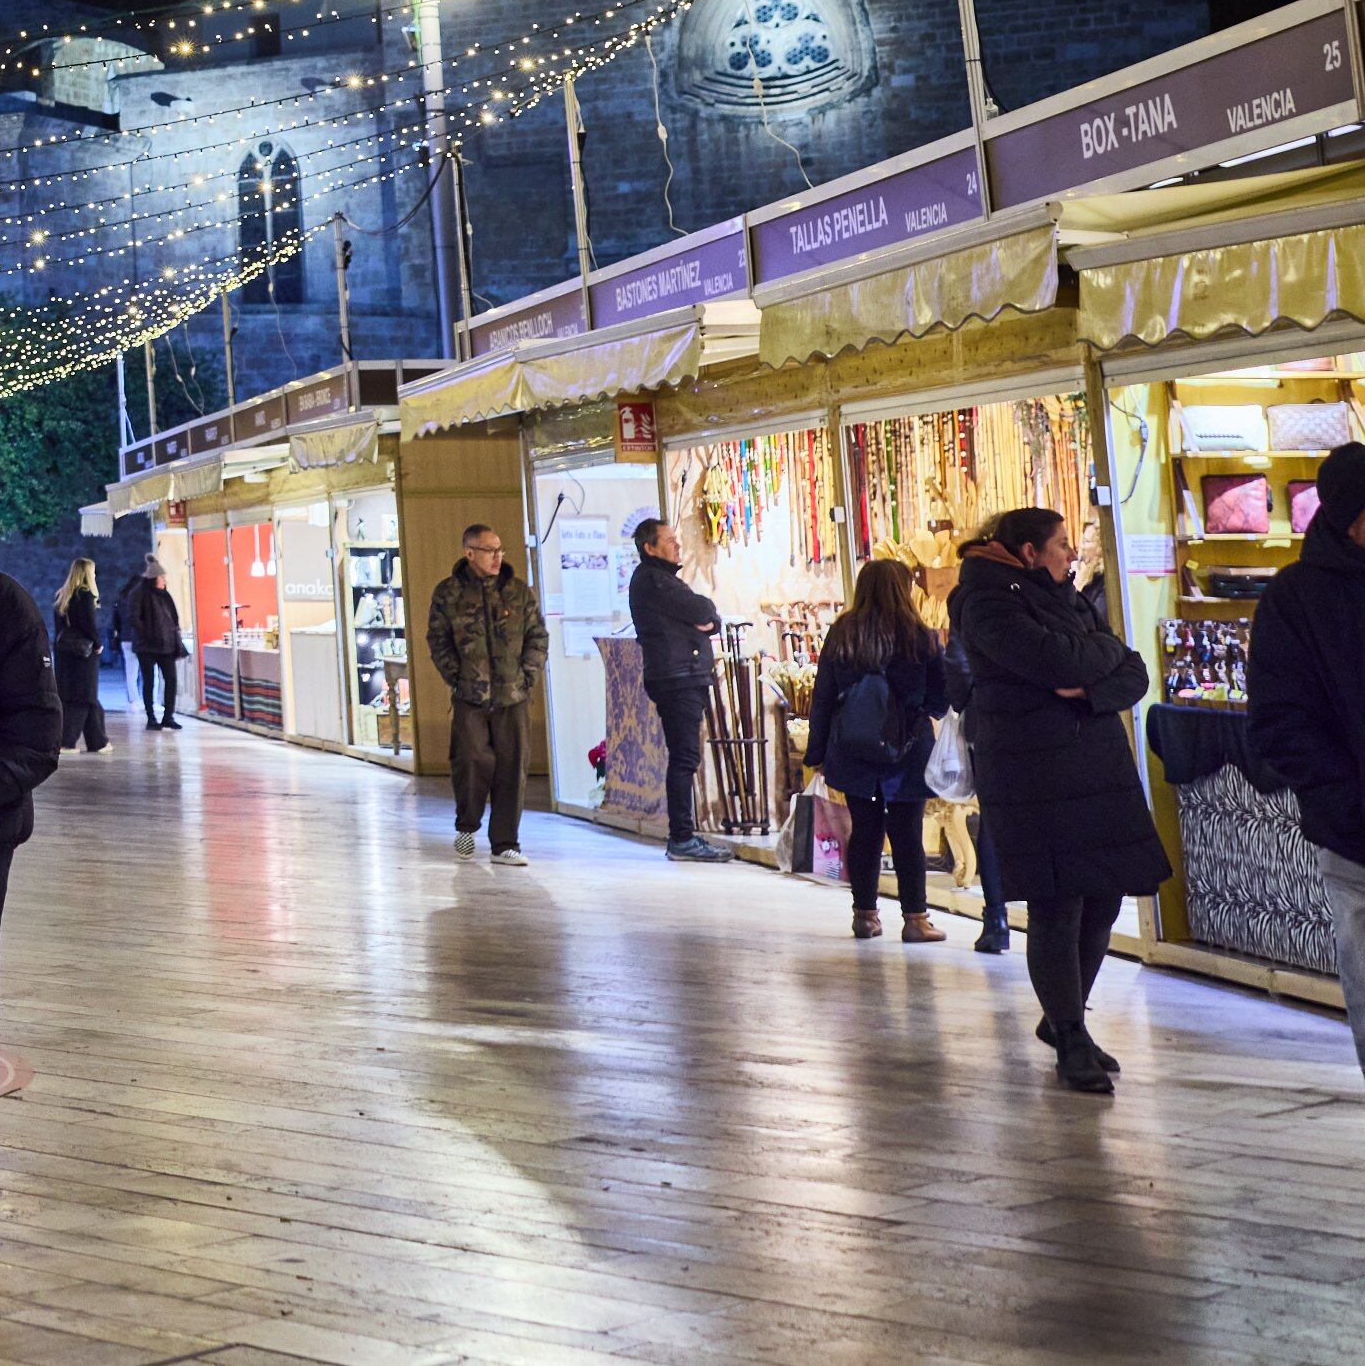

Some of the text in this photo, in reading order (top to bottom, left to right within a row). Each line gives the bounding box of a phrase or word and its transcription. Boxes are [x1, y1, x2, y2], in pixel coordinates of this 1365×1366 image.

[1323, 40, 1341, 71] 25
[1080, 93, 1177, 159] BOX -TANA
[1226, 88, 1296, 134] VALENCIA
[966, 171, 978, 196] 24
[789, 196, 888, 255] TALLAS PENELLA
[905, 202, 947, 233] VALENCIA
[616, 279, 658, 313] BASTONES
[658, 259, 701, 295] MARTÍNEZ
[704, 272, 733, 296] VALENCIA
